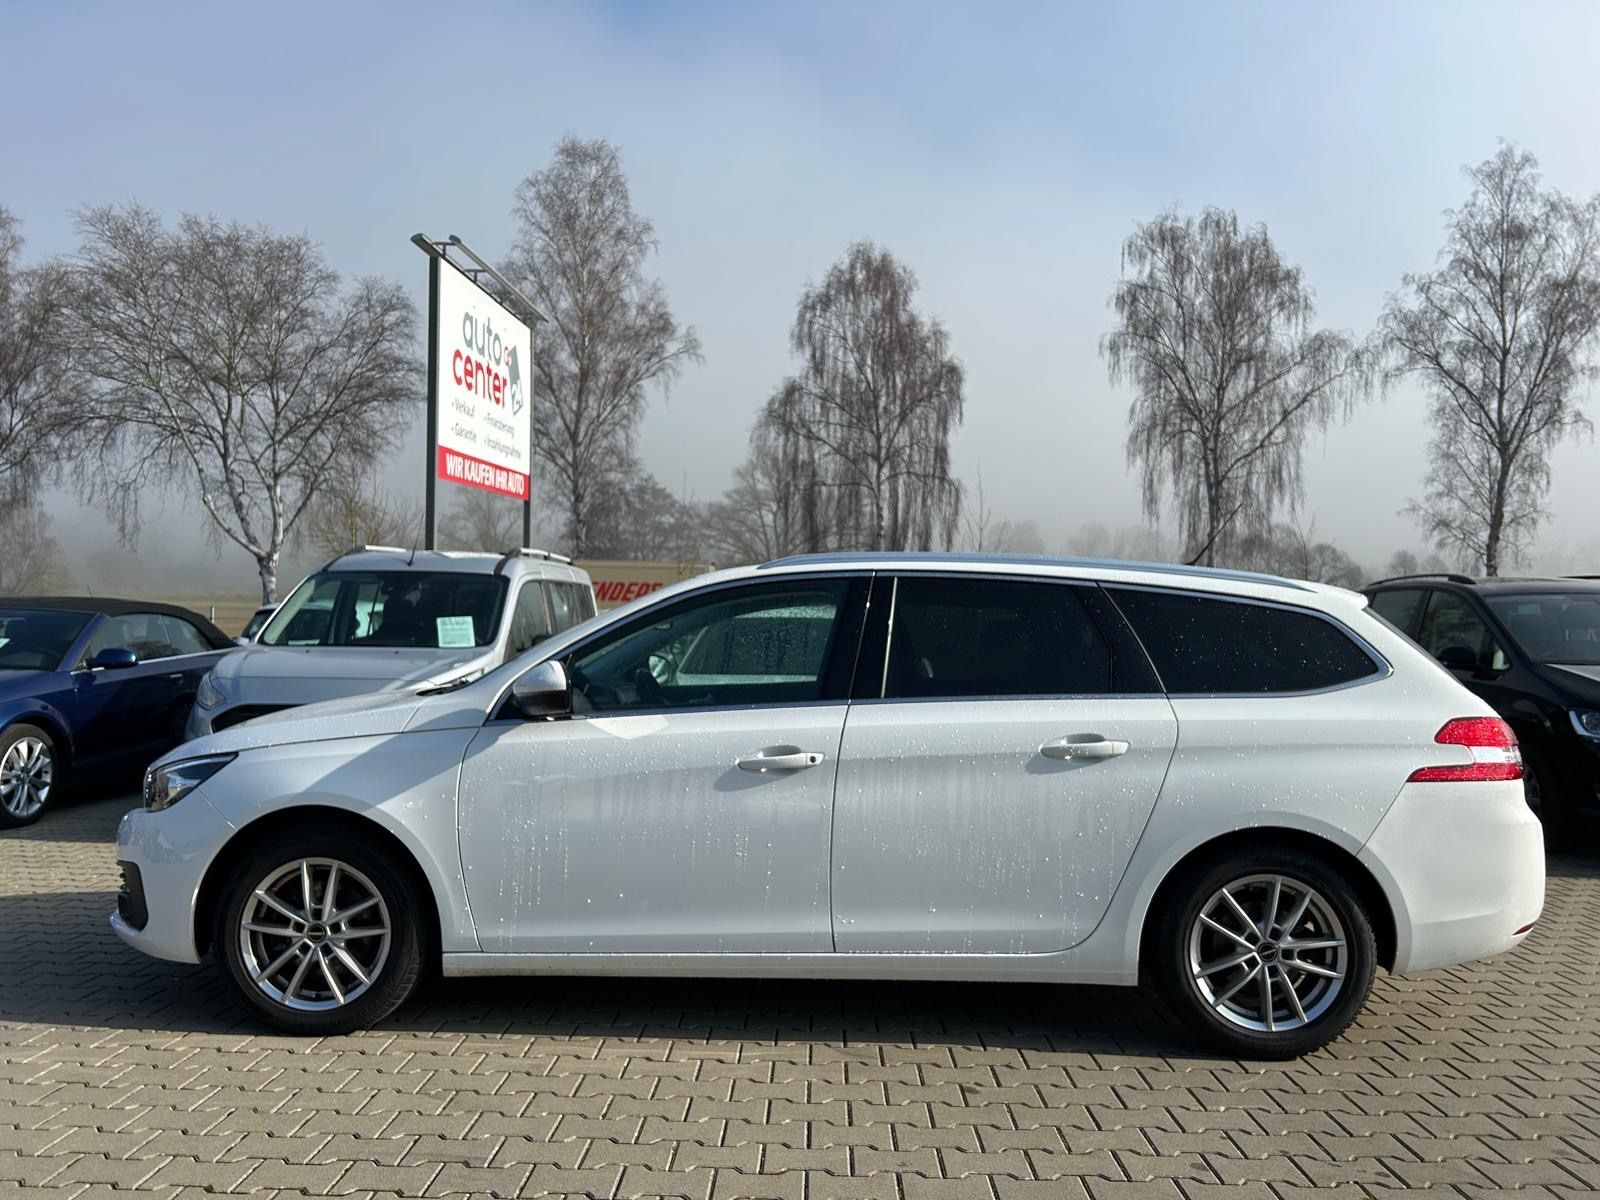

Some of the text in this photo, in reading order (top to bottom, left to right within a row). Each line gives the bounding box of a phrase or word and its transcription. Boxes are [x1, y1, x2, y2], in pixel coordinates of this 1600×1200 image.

[463, 312, 502, 366] auto
[453, 349, 508, 408] center
[446, 453, 525, 495] WIR KAUFEN IHR AUTO
